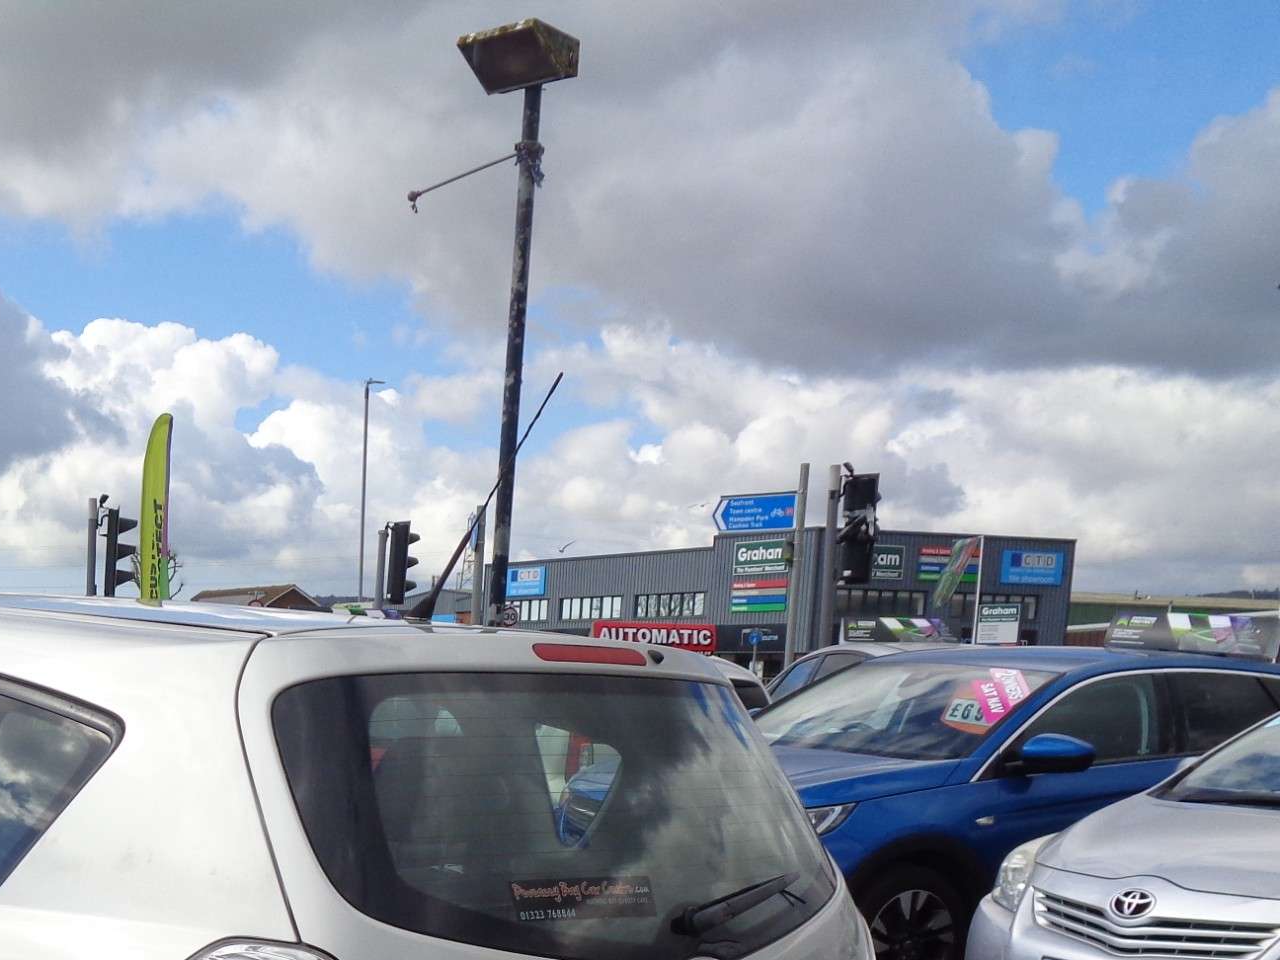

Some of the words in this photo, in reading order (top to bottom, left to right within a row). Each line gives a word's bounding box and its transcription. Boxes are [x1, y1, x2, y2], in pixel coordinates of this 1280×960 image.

[982, 606, 1017, 616] Graham
[504, 612, 516, 622] 30
[599, 627, 712, 645] AUTOMATIC
[519, 909, 546, 922] 01323
